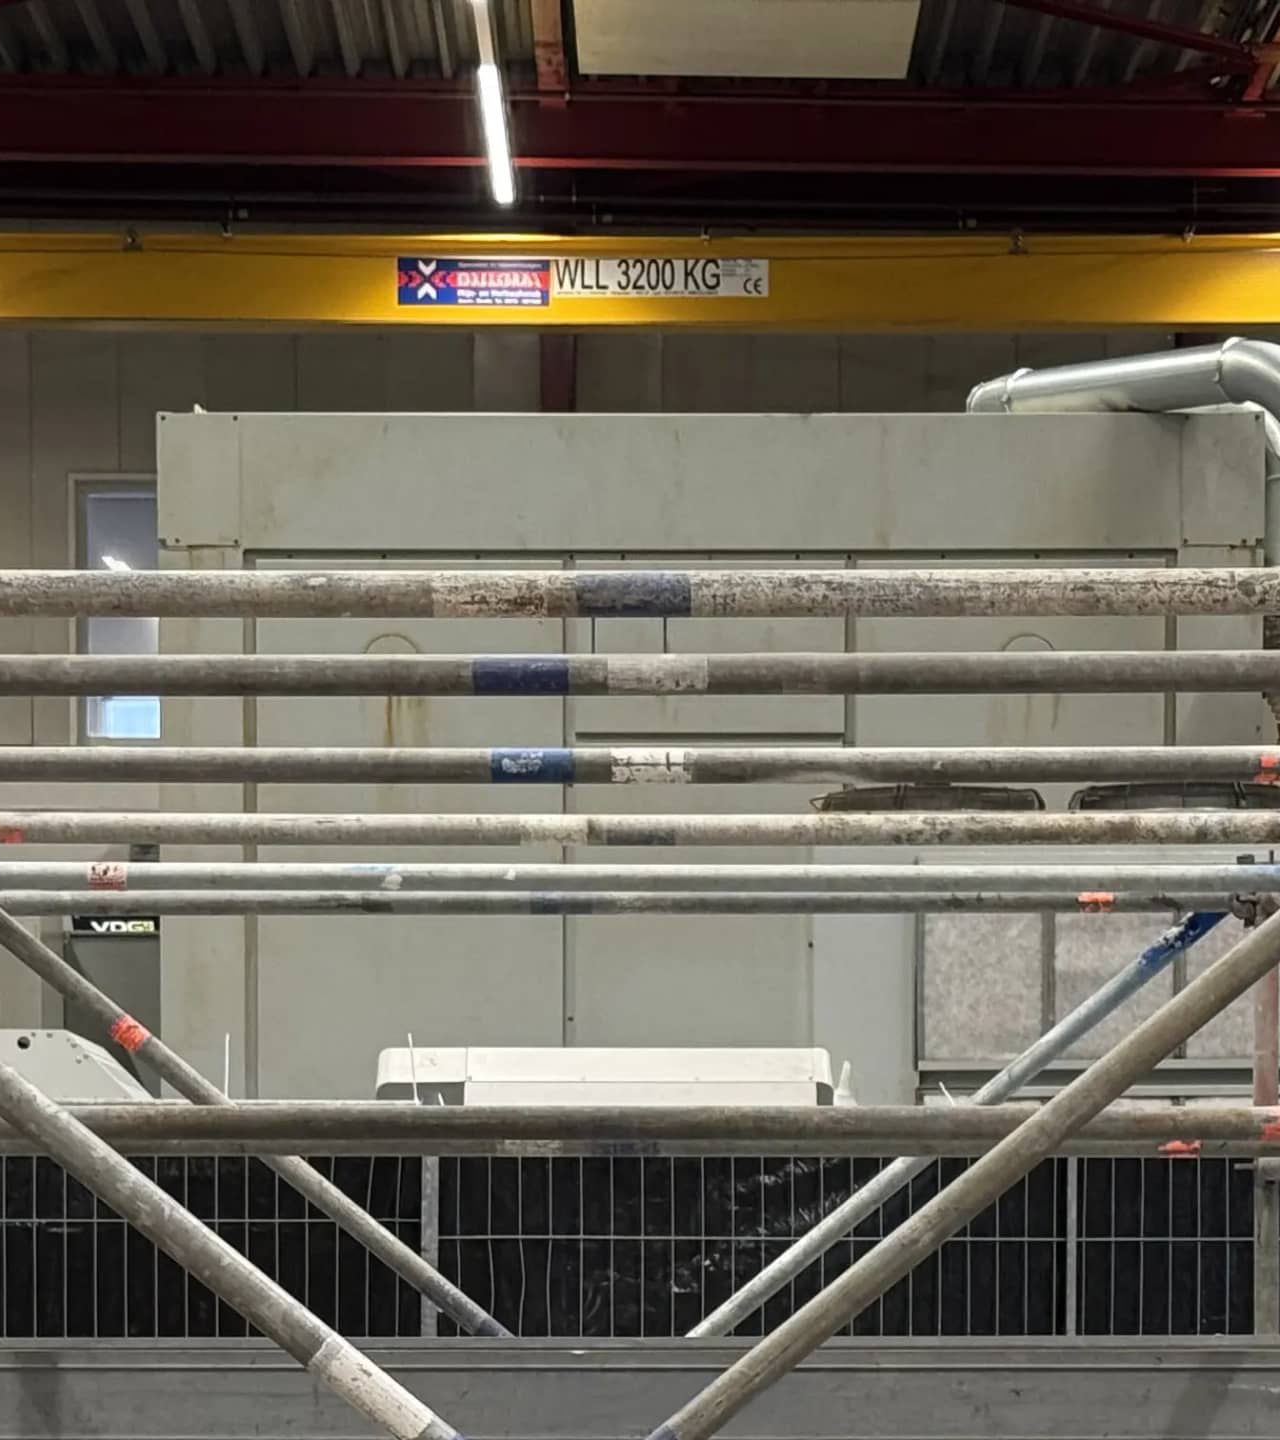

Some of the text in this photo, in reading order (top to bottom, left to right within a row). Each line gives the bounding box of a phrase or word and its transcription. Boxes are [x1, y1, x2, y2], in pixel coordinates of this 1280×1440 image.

[555, 258, 608, 291] WLL
[616, 258, 675, 292] 3200
[685, 258, 720, 292] KG
